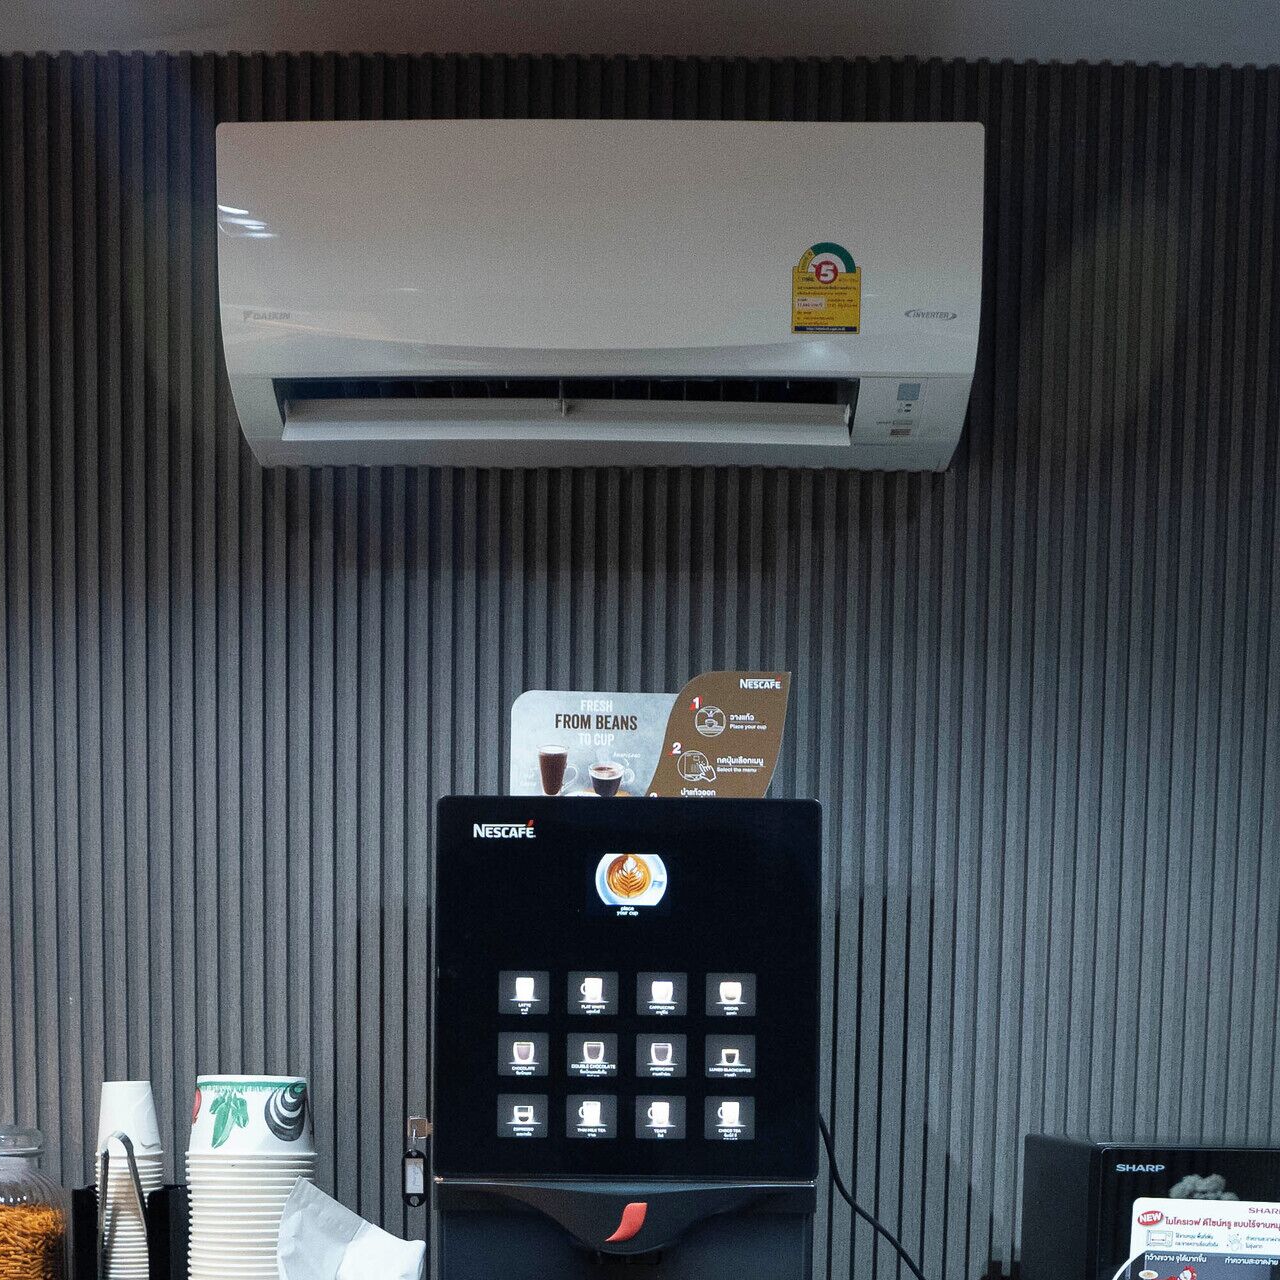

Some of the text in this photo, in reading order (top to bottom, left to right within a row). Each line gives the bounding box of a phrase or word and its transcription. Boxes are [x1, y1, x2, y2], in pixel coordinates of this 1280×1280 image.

[819, 262, 836, 284] 5
[912, 311, 950, 320] INVERTER
[580, 699, 613, 713] FRESH
[692, 696, 700, 709] 1
[555, 713, 638, 731] FROM BEANS
[578, 732, 615, 747] TO CUP
[672, 742, 682, 755] 2
[1115, 1163, 1165, 1173] SHARP
[1138, 1211, 1163, 1224] NEW
[1165, 1216, 1202, 1226] ไมโครเวฟ
